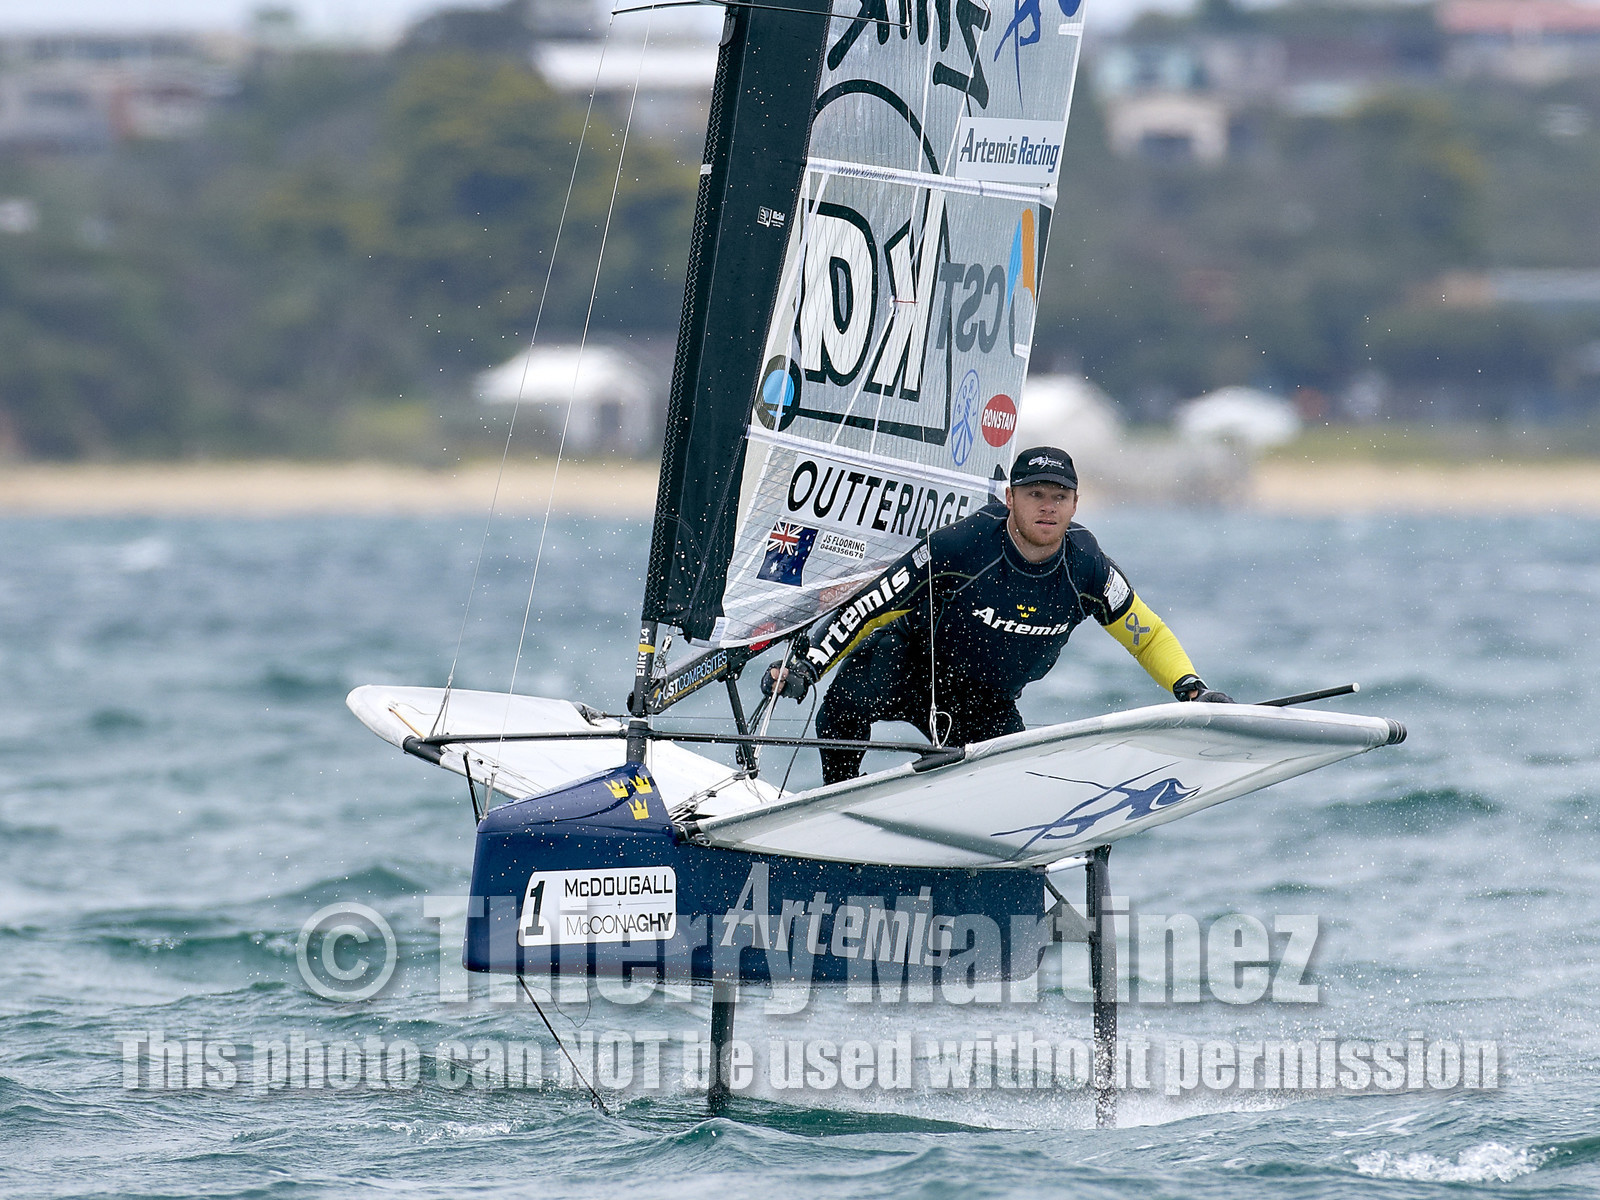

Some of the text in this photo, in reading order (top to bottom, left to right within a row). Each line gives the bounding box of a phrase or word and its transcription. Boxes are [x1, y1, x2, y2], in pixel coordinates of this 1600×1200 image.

[960, 128, 1060, 173] Artemis Racing
[982, 408, 1016, 431] RONSTAN
[823, 534, 866, 553] JS FLOORING
[972, 607, 1070, 636] Artemis
[564, 874, 673, 898] McDOUGALL
[525, 880, 545, 936] 1
[719, 862, 955, 967] Artemis
[566, 912, 673, 936] McCONAGHY
